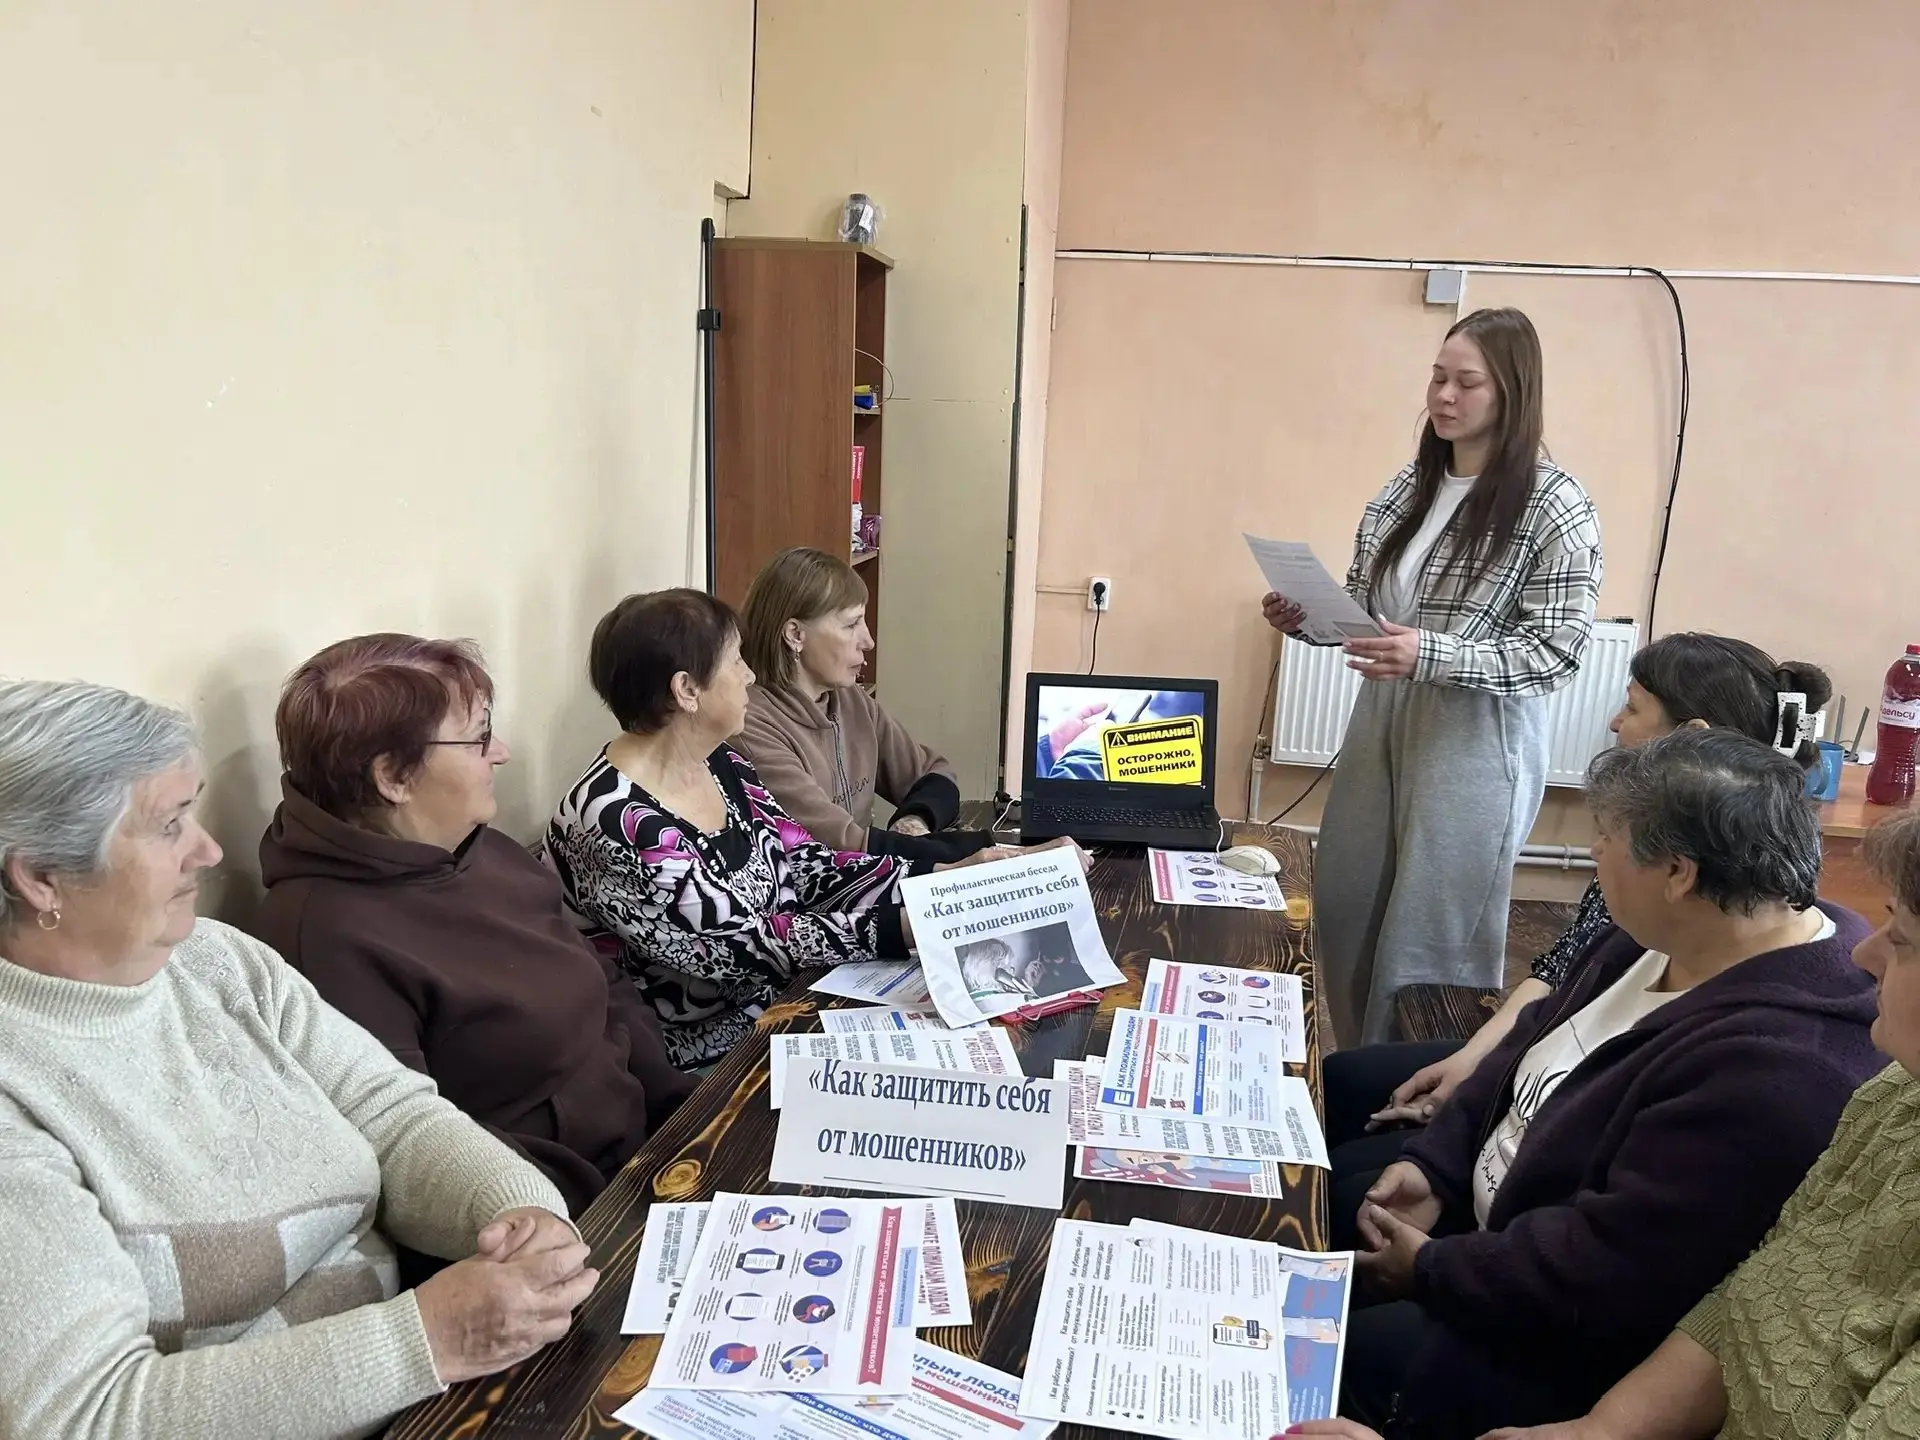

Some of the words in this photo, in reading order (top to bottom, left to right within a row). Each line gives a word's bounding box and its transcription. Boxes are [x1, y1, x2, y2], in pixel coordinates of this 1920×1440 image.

[1127, 726, 1193, 742] ВНИМАНИЕ
[1118, 760, 1196, 777] МОШЕННИКИ
[930, 870, 1026, 897] Профилактическая
[1028, 864, 1058, 877] беседа
[923, 901, 964, 919] «Как
[967, 887, 1043, 911] защитить
[1046, 876, 1079, 894] себя
[942, 927, 961, 940] от
[964, 901, 1074, 935] мошенников»
[809, 1059, 865, 1096] «Как
[872, 1072, 990, 1110] защитить
[996, 1077, 1052, 1114] себя
[1117, 1074, 1126, 1088] КАК
[818, 1129, 846, 1153] от
[850, 1132, 1026, 1172] мошенников»
[887, 1215, 896, 1228] Как
[880, 1271, 887, 1279] от
